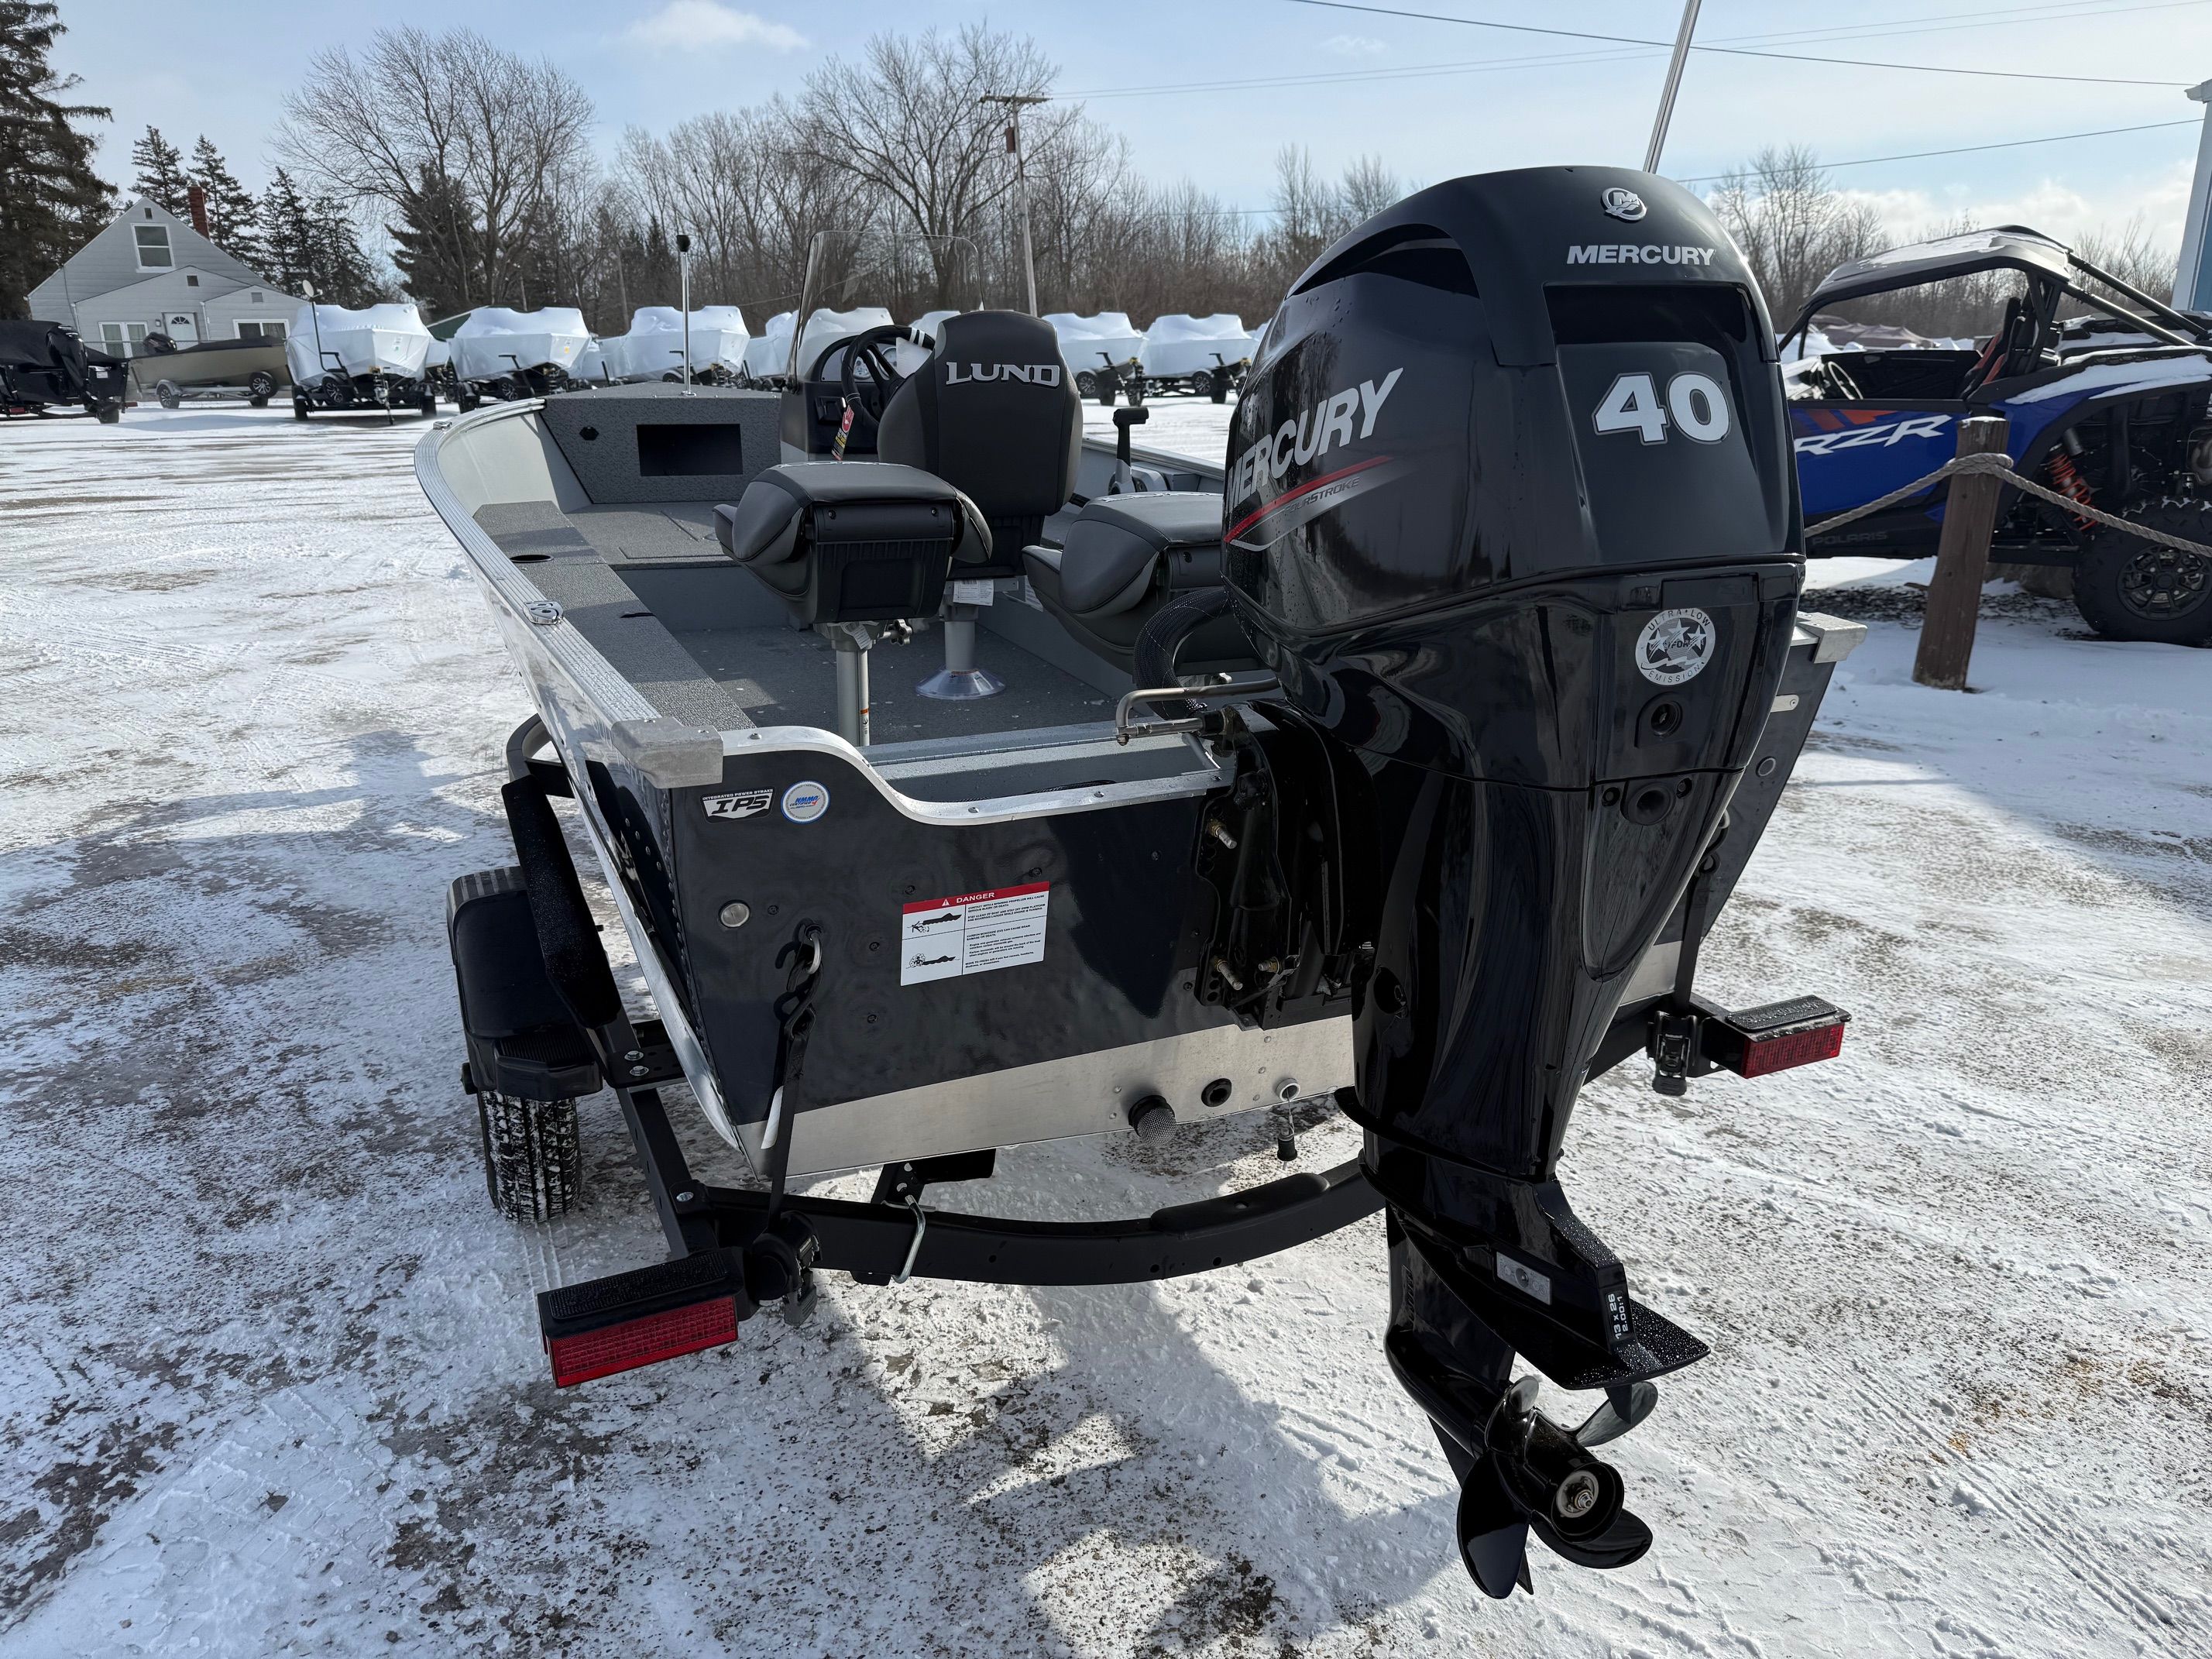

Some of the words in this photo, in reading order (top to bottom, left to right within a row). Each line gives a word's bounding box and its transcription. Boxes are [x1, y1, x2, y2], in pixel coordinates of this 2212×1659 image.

[1566, 244, 1715, 266] MERCURY
[946, 362, 1060, 387] LUND
[1592, 372, 1731, 444] 40
[1224, 367, 1403, 517] MERCURY
[1793, 414, 1952, 455] RZR
[1812, 531, 1887, 545] POLARIS
[1690, 610, 1710, 627] LOW
[1648, 664, 1700, 683] EMISSION
[711, 795, 770, 815] IPS
[957, 892, 994, 904] DANGER
[1607, 1293, 1617, 1312] 26
[1616, 1296, 1629, 1332] 2.00:1
[1613, 1324, 1622, 1340] 13
